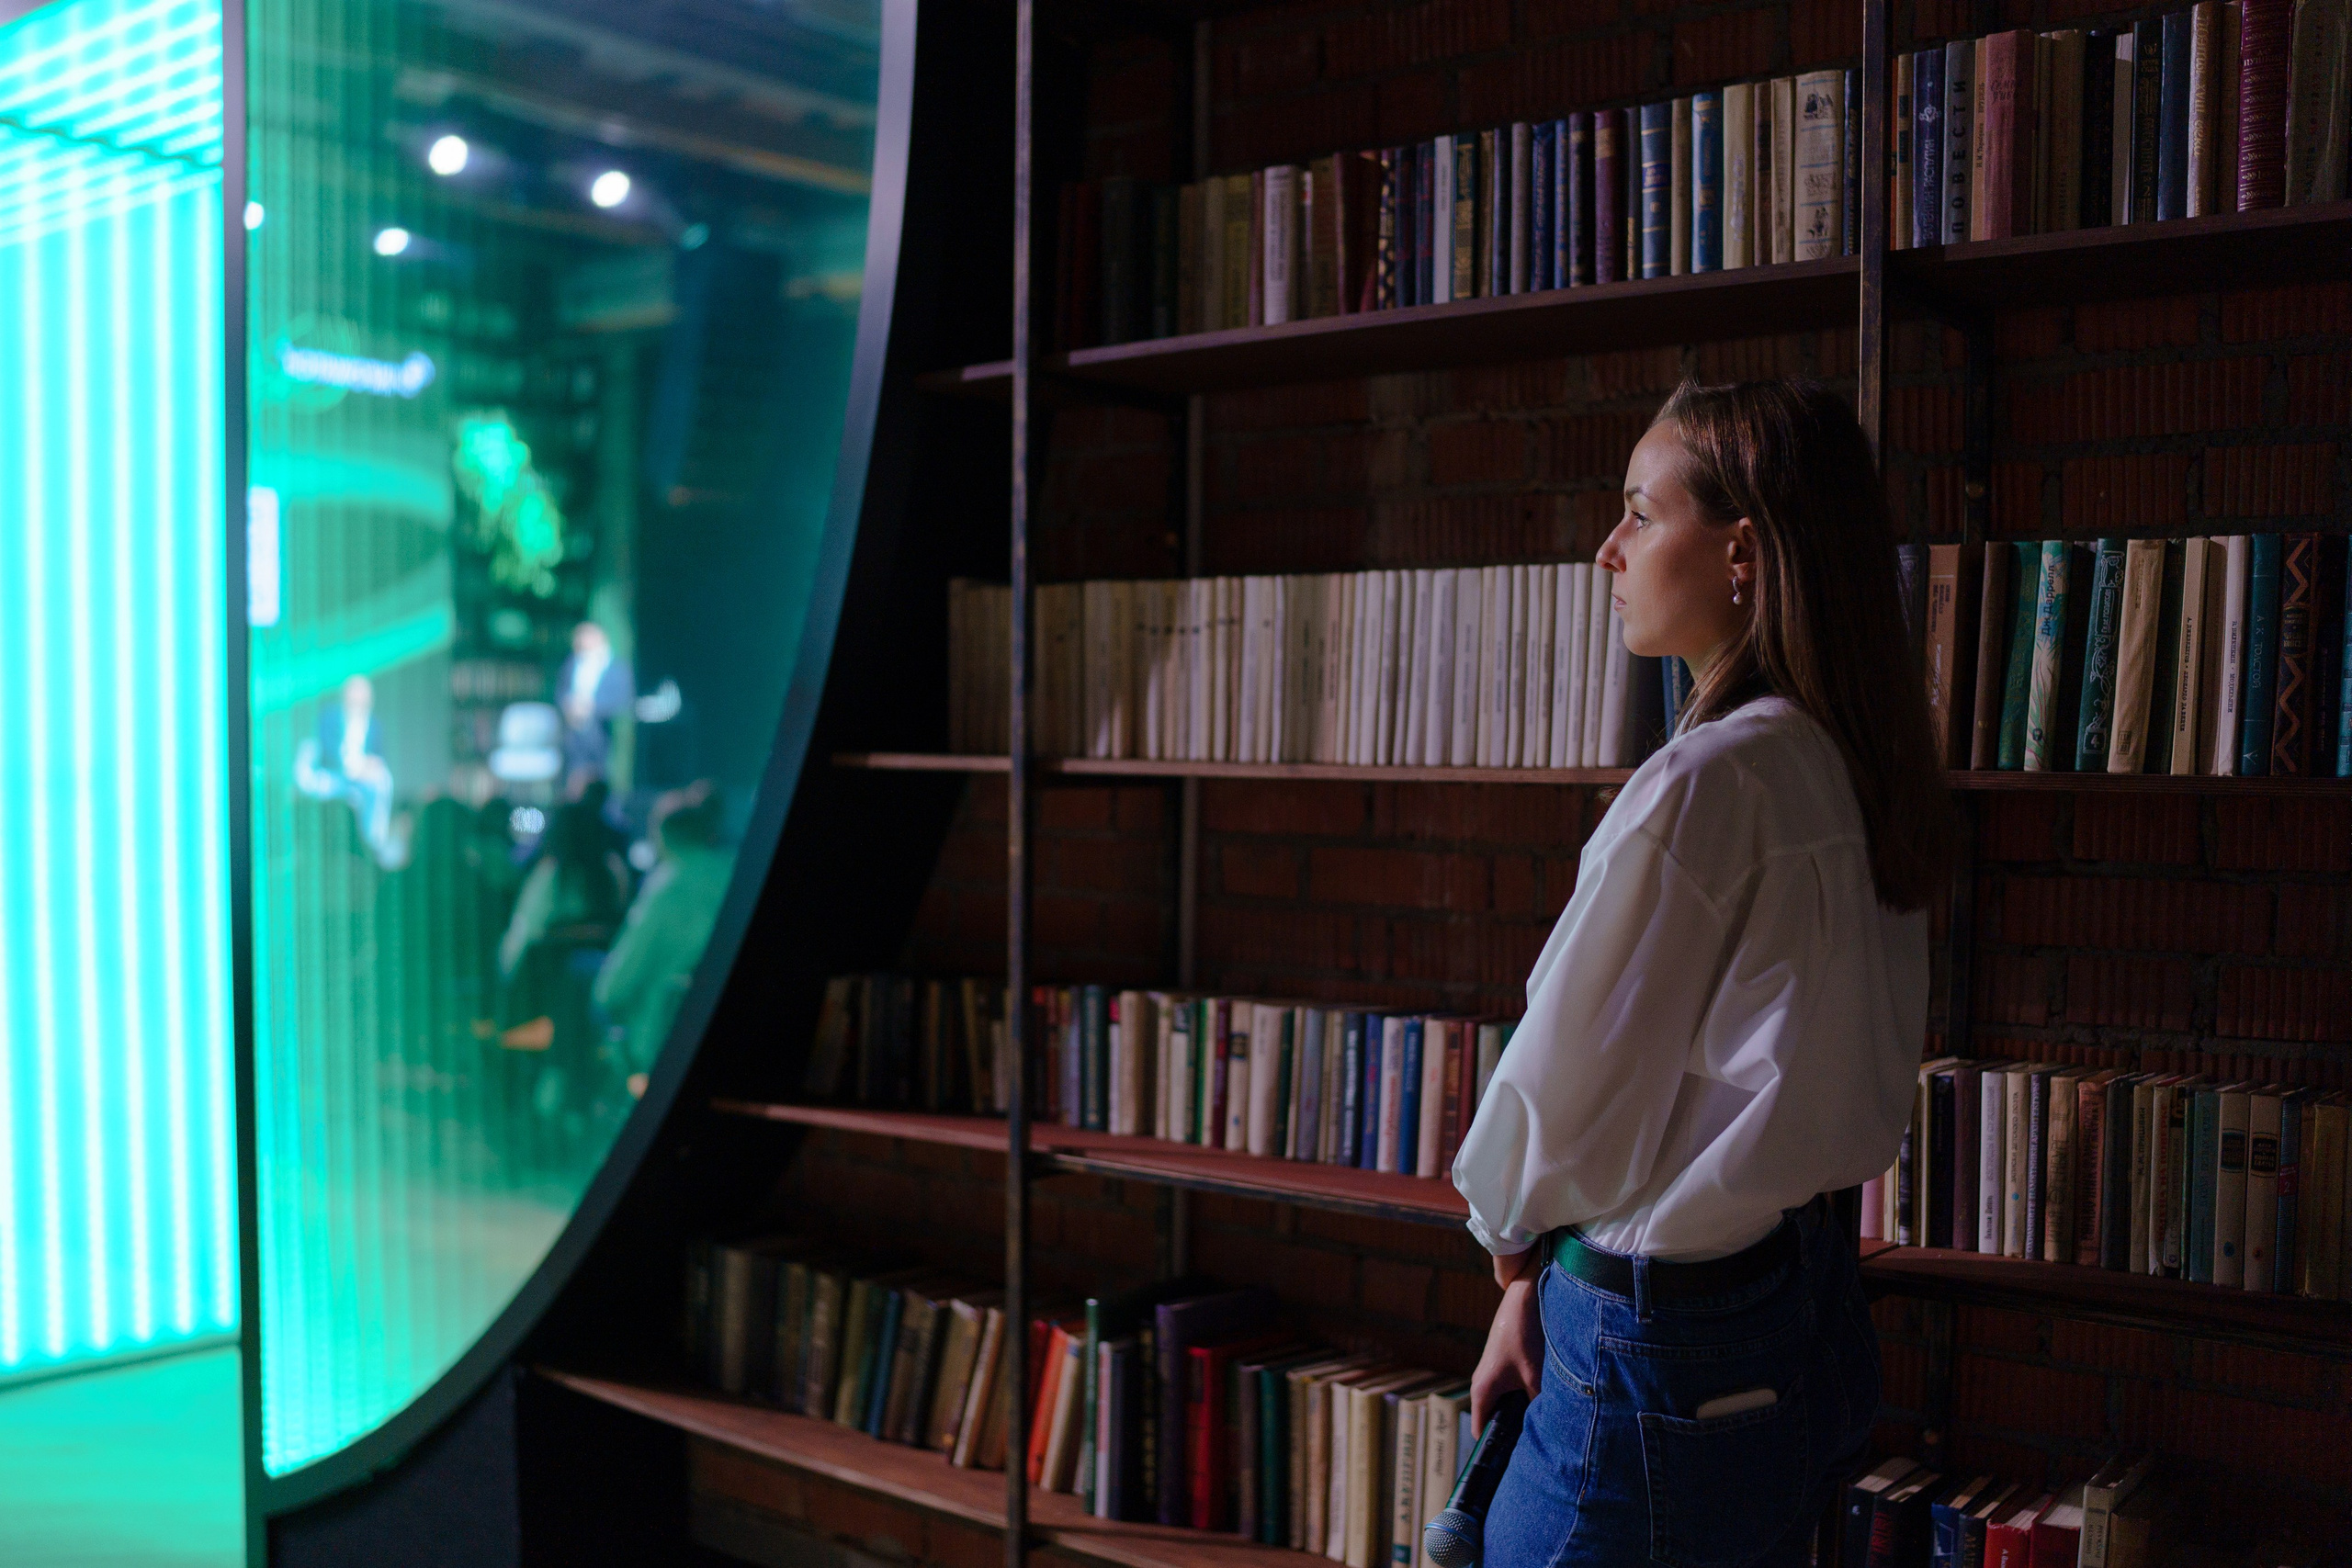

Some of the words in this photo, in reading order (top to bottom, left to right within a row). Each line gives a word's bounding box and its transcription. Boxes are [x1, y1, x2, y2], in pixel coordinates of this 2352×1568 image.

[1923, 139, 1937, 188] РАСПУТИН
[1951, 79, 1966, 233] ПОВЕСТИ
[2043, 565, 2055, 615] Даррелл
[2252, 641, 2264, 689] ТОЛСТОЙ
[2090, 733, 2100, 749] 4
[2138, 1106, 2147, 1153] ПРИШВИН
[2159, 1102, 2169, 1164] ПОВЕРКЕ
